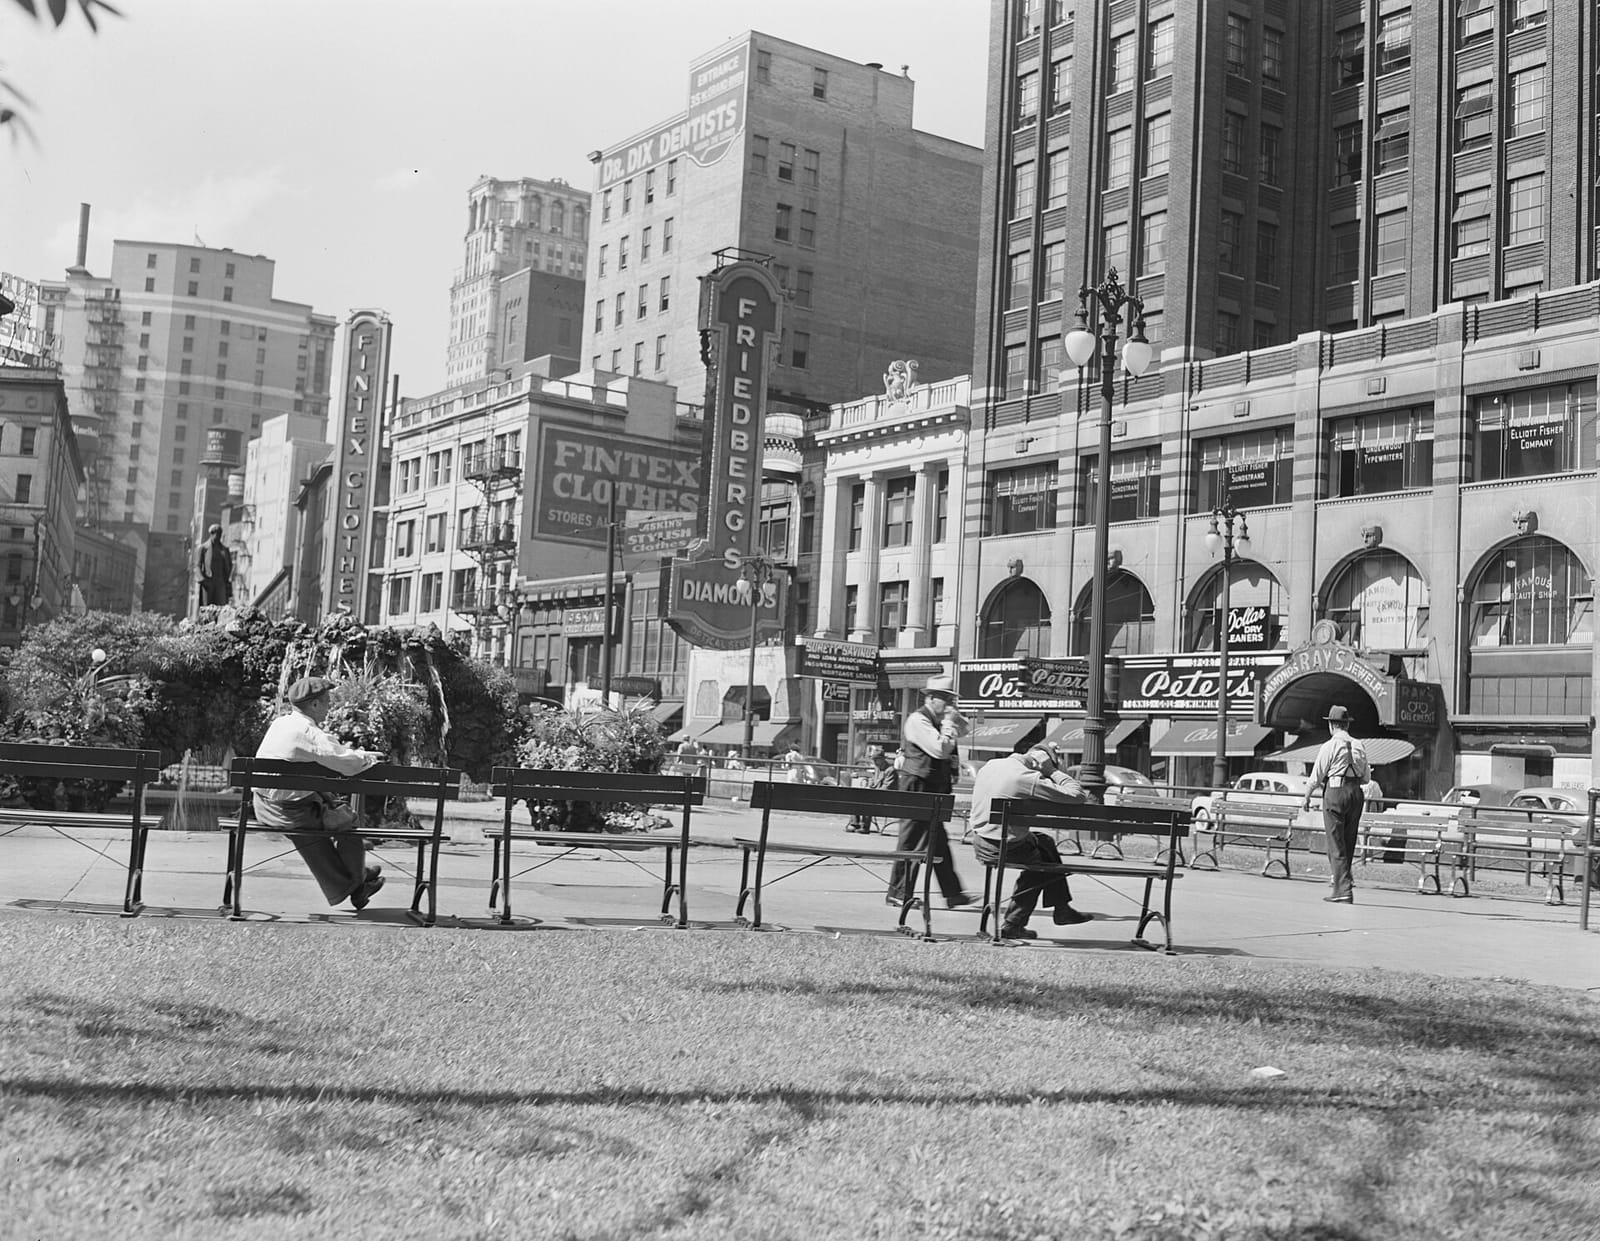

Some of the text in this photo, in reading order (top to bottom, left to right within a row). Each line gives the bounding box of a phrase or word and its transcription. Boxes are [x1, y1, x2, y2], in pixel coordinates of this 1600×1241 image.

[603, 158, 625, 184] DR.
[627, 139, 654, 174] DIX
[660, 99, 737, 158] DENTISTS
[349, 335, 373, 456] FINTEX
[1510, 425, 1564, 439] ELLIOTT FISHER
[1520, 438, 1553, 449] COMPANY
[554, 439, 701, 488] FINTEX
[1364, 452, 1403, 464] TYPEWRITERS
[553, 472, 699, 513] CLOTHES
[548, 509, 592, 526] STORES
[337, 471, 364, 616] CLOTHES
[627, 528, 691, 545] STYLISH
[1228, 606, 1266, 633] Dollar
[1244, 625, 1263, 633] DRY
[1220, 632, 1264, 643] EANERS
[1141, 669, 1255, 697] Petes'
[1345, 663, 1387, 698] JEWELRY
[1185, 700, 1219, 708] SWIMMIN
